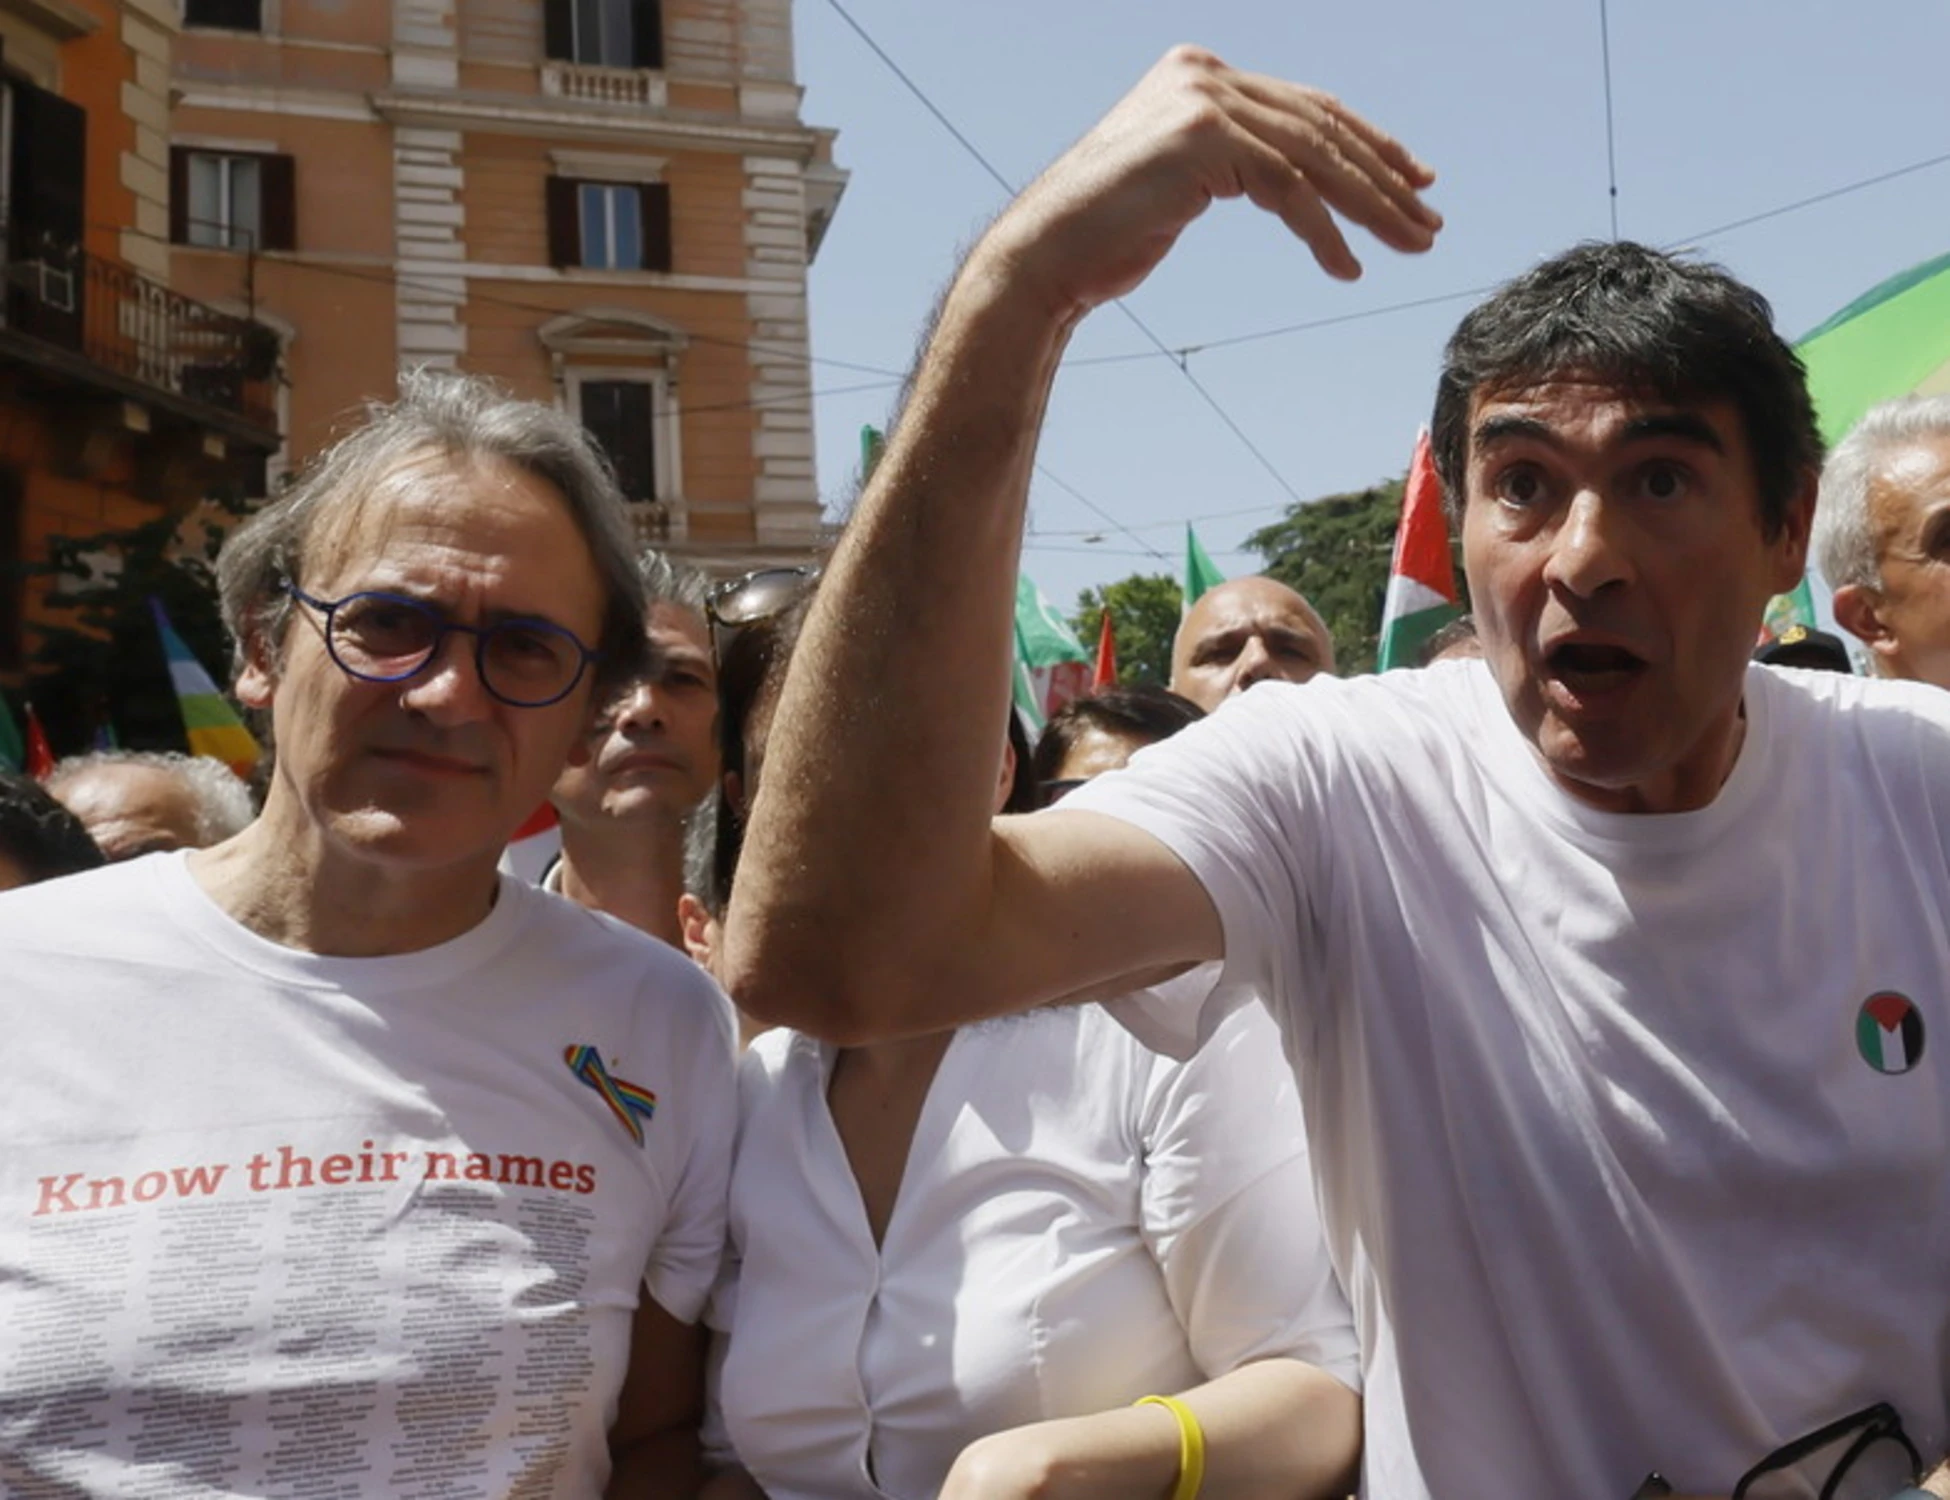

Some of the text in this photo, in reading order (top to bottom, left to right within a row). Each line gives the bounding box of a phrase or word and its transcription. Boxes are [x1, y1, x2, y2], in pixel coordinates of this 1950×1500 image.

[31, 1140, 597, 1217] Know their names
